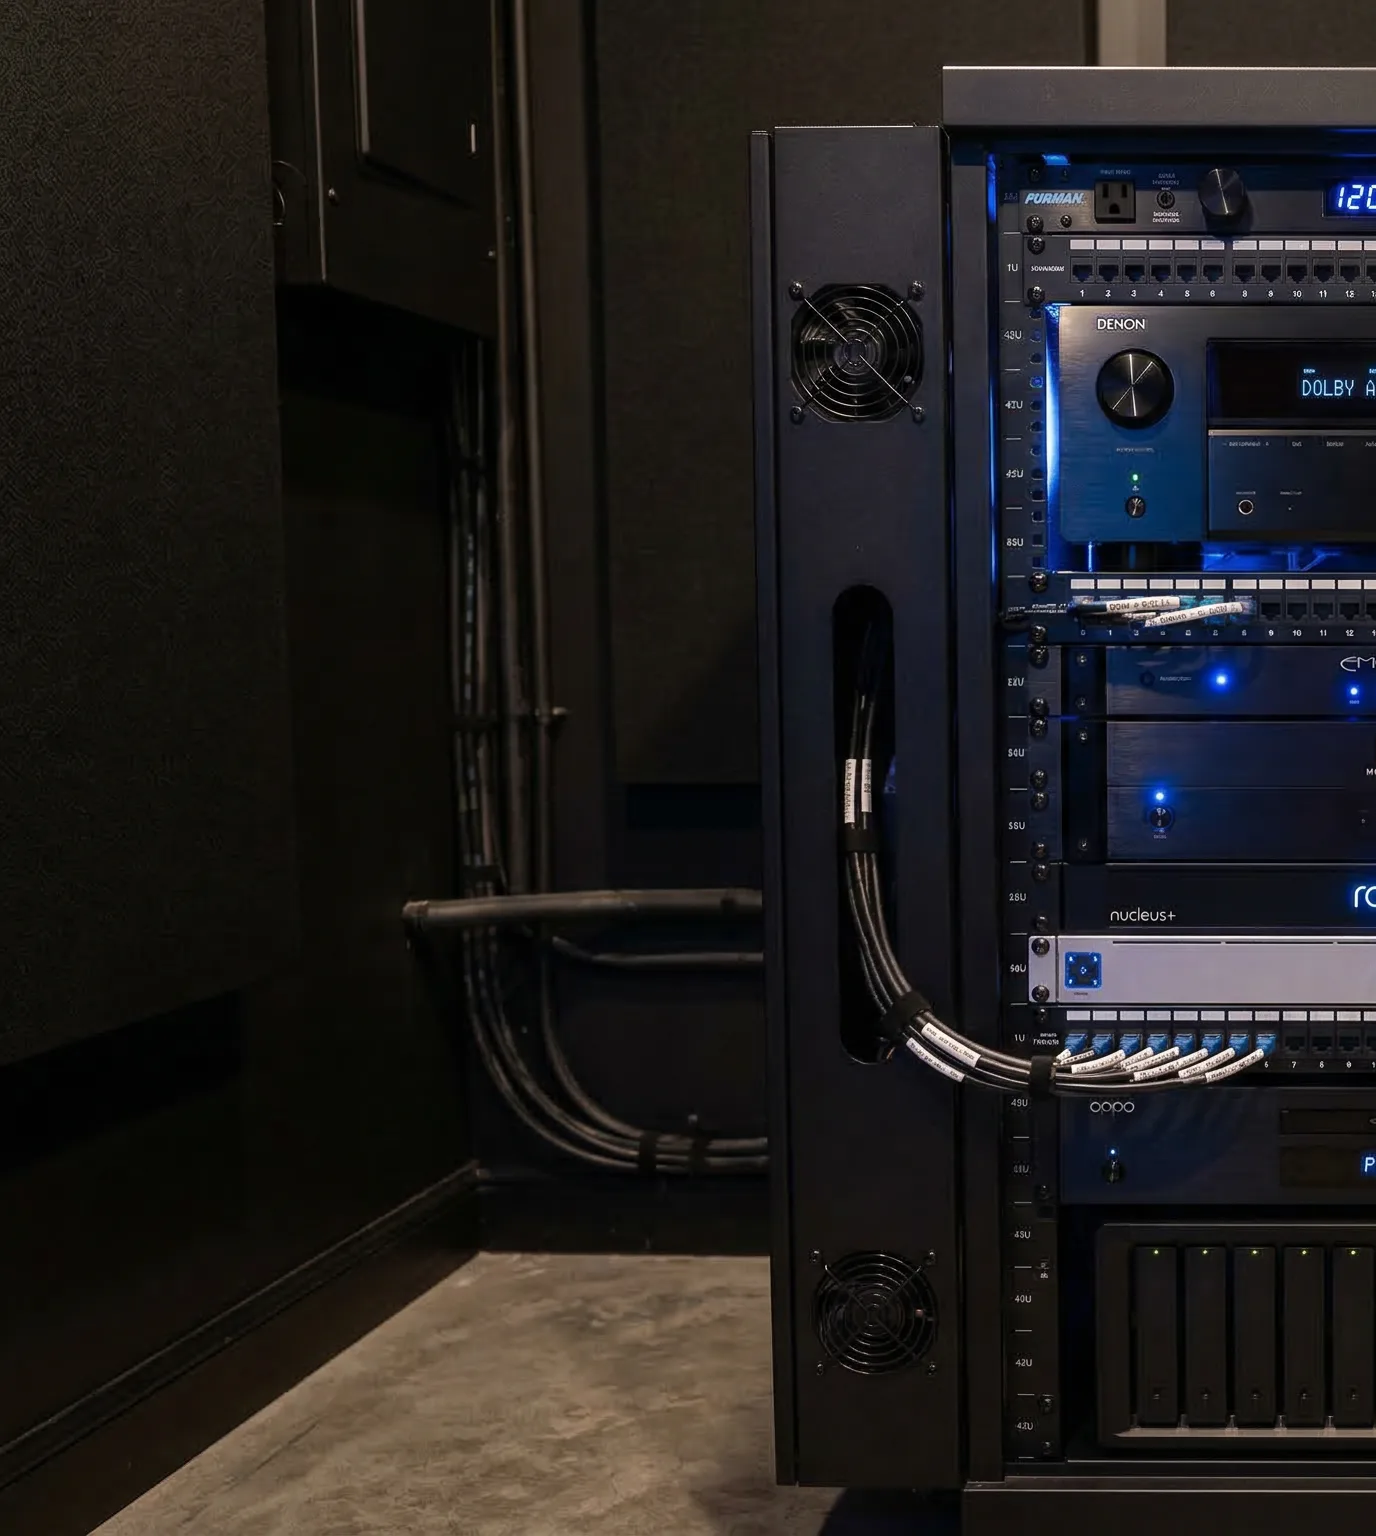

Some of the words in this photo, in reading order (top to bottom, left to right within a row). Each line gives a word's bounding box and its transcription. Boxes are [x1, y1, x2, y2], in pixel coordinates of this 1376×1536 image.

[1007, 263, 1018, 272] 1U
[1079, 289, 1085, 298] 1
[1130, 289, 1137, 298] 3
[1157, 289, 1164, 297] 4
[1318, 289, 1327, 298] 11
[1097, 318, 1146, 331] DENON
[1302, 379, 1356, 397] DOLBY
[1292, 629, 1302, 637] 10
[1319, 629, 1327, 637] 11
[1110, 907, 1176, 922] nucleus+
[1014, 1034, 1024, 1042] 1U
[1264, 1060, 1269, 1069] 6
[1291, 1060, 1297, 1069] 7
[1015, 1294, 1032, 1303] 40U
[1015, 1358, 1033, 1367] 42U
